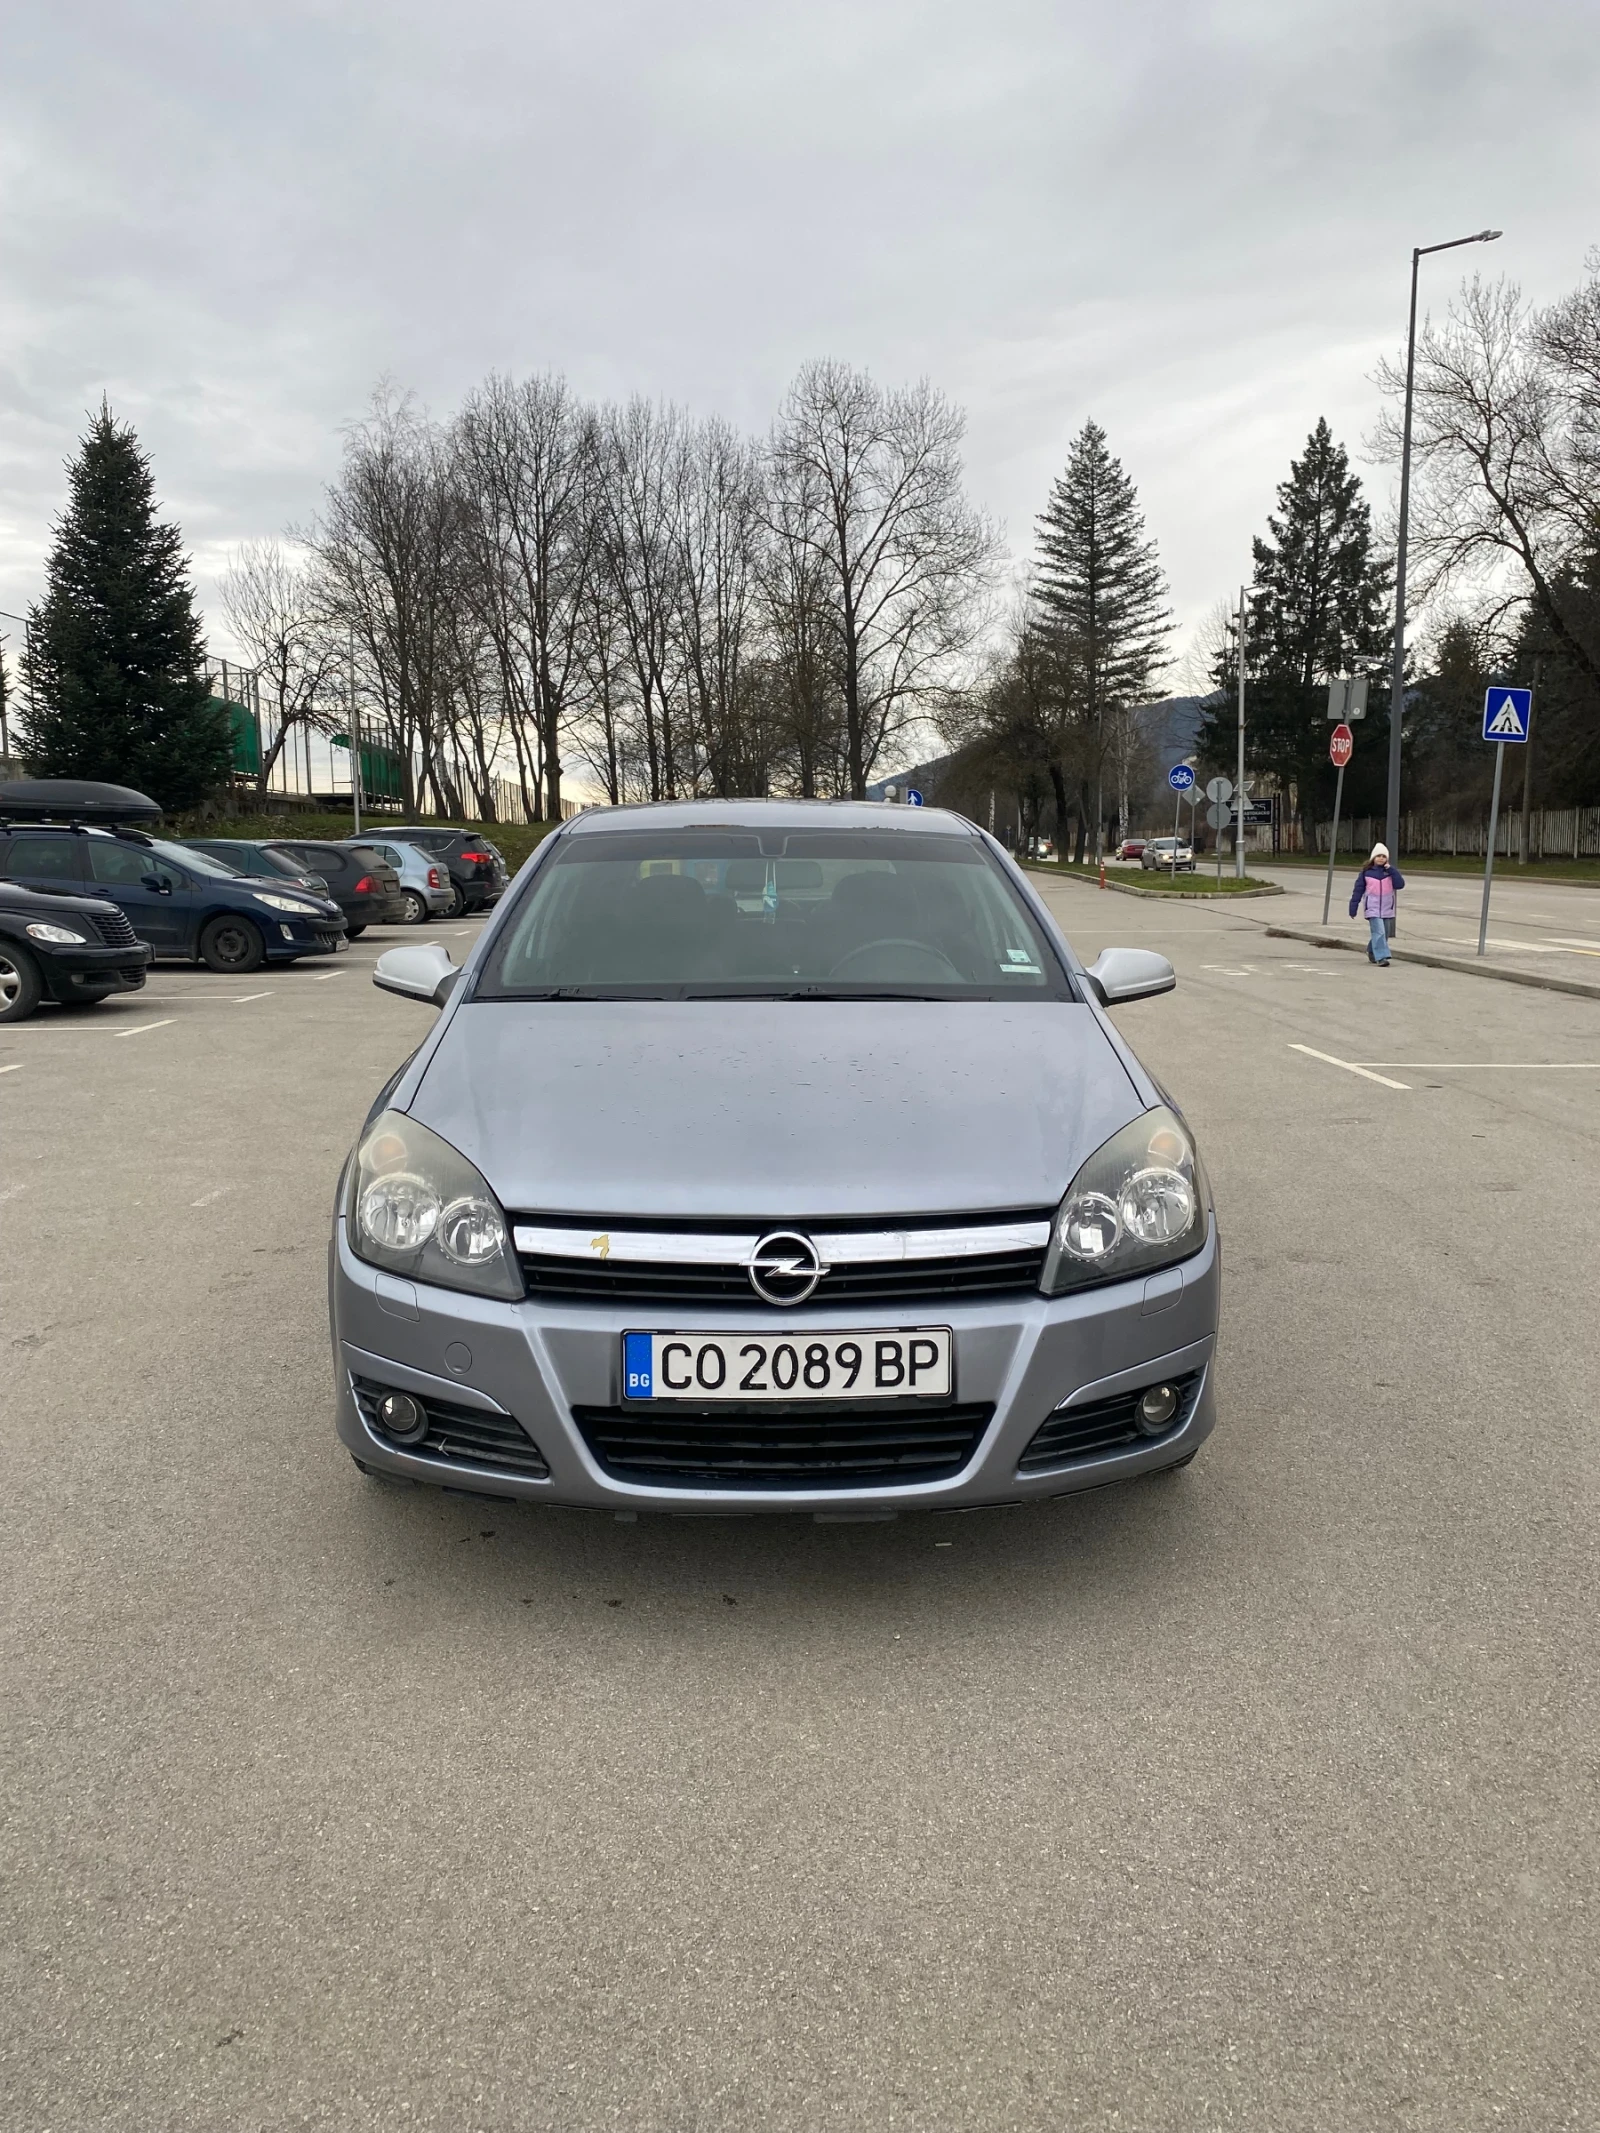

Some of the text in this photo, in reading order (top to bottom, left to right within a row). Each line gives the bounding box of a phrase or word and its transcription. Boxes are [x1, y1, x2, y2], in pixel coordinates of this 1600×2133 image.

[1332, 738, 1350, 753] STOP
[662, 1340, 939, 1391] CO 2089 BP
[629, 1373, 651, 1387] BG
